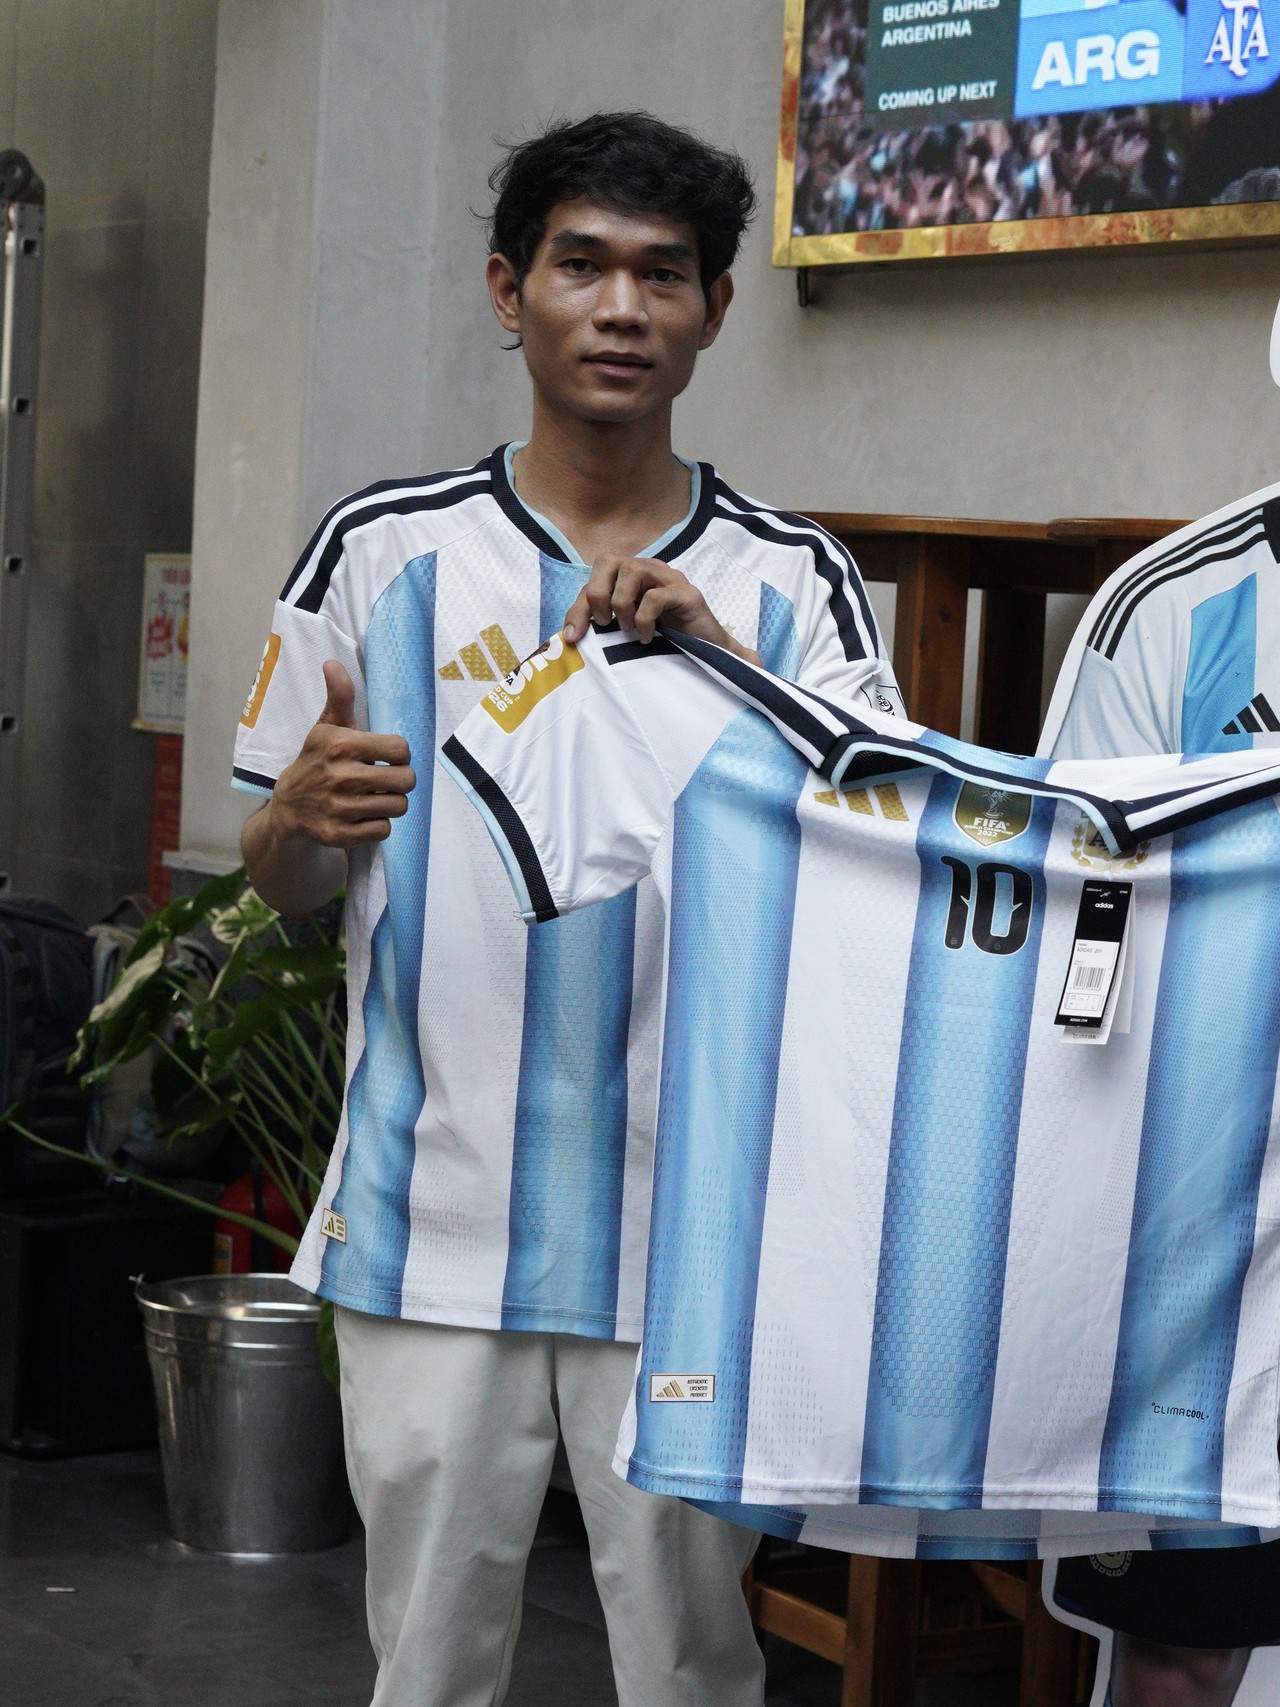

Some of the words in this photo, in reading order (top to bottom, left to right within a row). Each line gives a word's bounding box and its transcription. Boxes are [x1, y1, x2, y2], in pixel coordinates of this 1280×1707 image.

[883, 0, 948, 23] BUENOS
[881, 19, 972, 47] ARGENTINA
[1031, 29, 1160, 90] ARG
[878, 88, 934, 111] COMING
[937, 86, 957, 104] UP
[959, 80, 998, 101] NEXT
[974, 817, 1007, 830] FIFA
[977, 830, 998, 838] 2022
[940, 855, 1033, 956] 10
